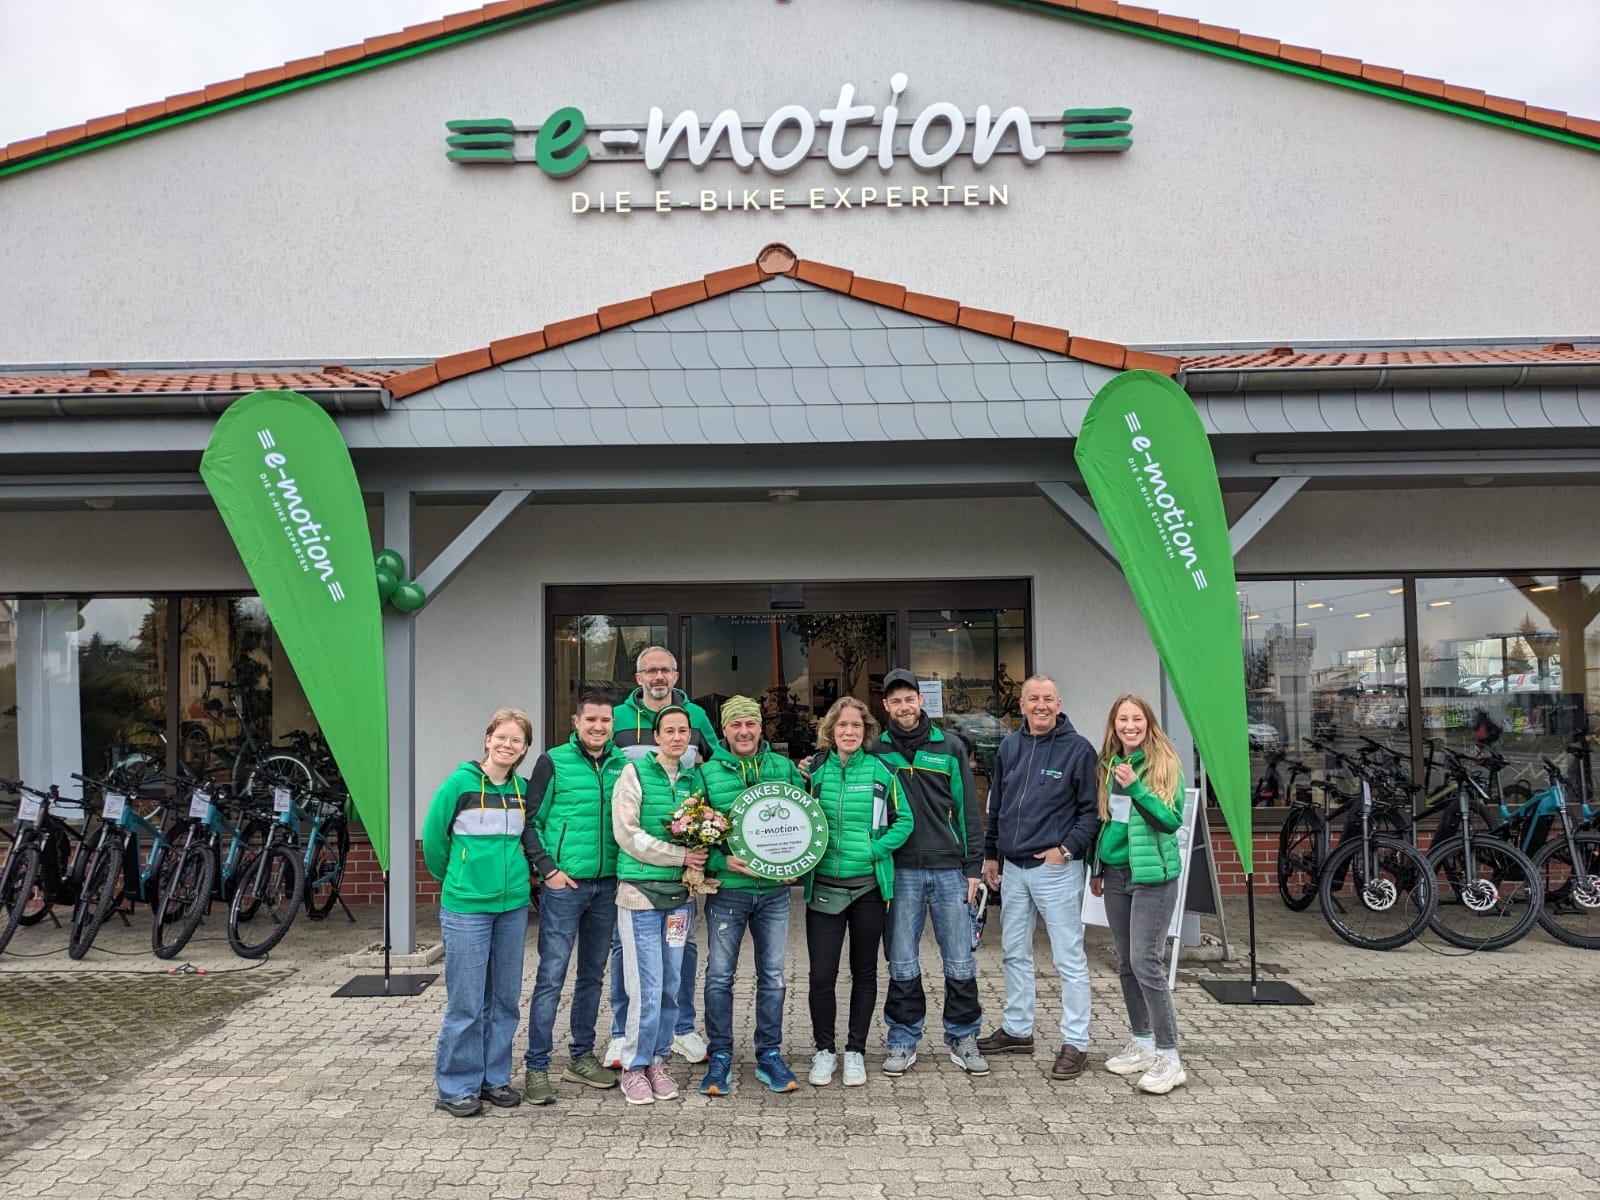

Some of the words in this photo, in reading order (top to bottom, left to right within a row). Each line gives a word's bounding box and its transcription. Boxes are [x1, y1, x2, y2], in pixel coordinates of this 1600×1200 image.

[535, 72, 1046, 177] e-motion
[571, 191, 632, 214] DIE
[655, 190, 786, 212] E-BIKE
[810, 184, 1009, 209] EXPERTEN
[259, 473, 271, 489] DIE
[268, 491, 287, 523] E-BIKE
[284, 526, 310, 572] EXPERTEN
[264, 452, 334, 582] e-motion
[1128, 458, 1138, 473] DIE
[1136, 476, 1153, 508] E-BIKE
[1151, 511, 1175, 559] EXPERTEN
[1131, 435, 1198, 570] e-motion
[733, 785, 780, 815] E-BIKES
[783, 786, 812, 808] VOM
[755, 824, 800, 835] e-motion
[750, 852, 817, 876] EXPERTEN
